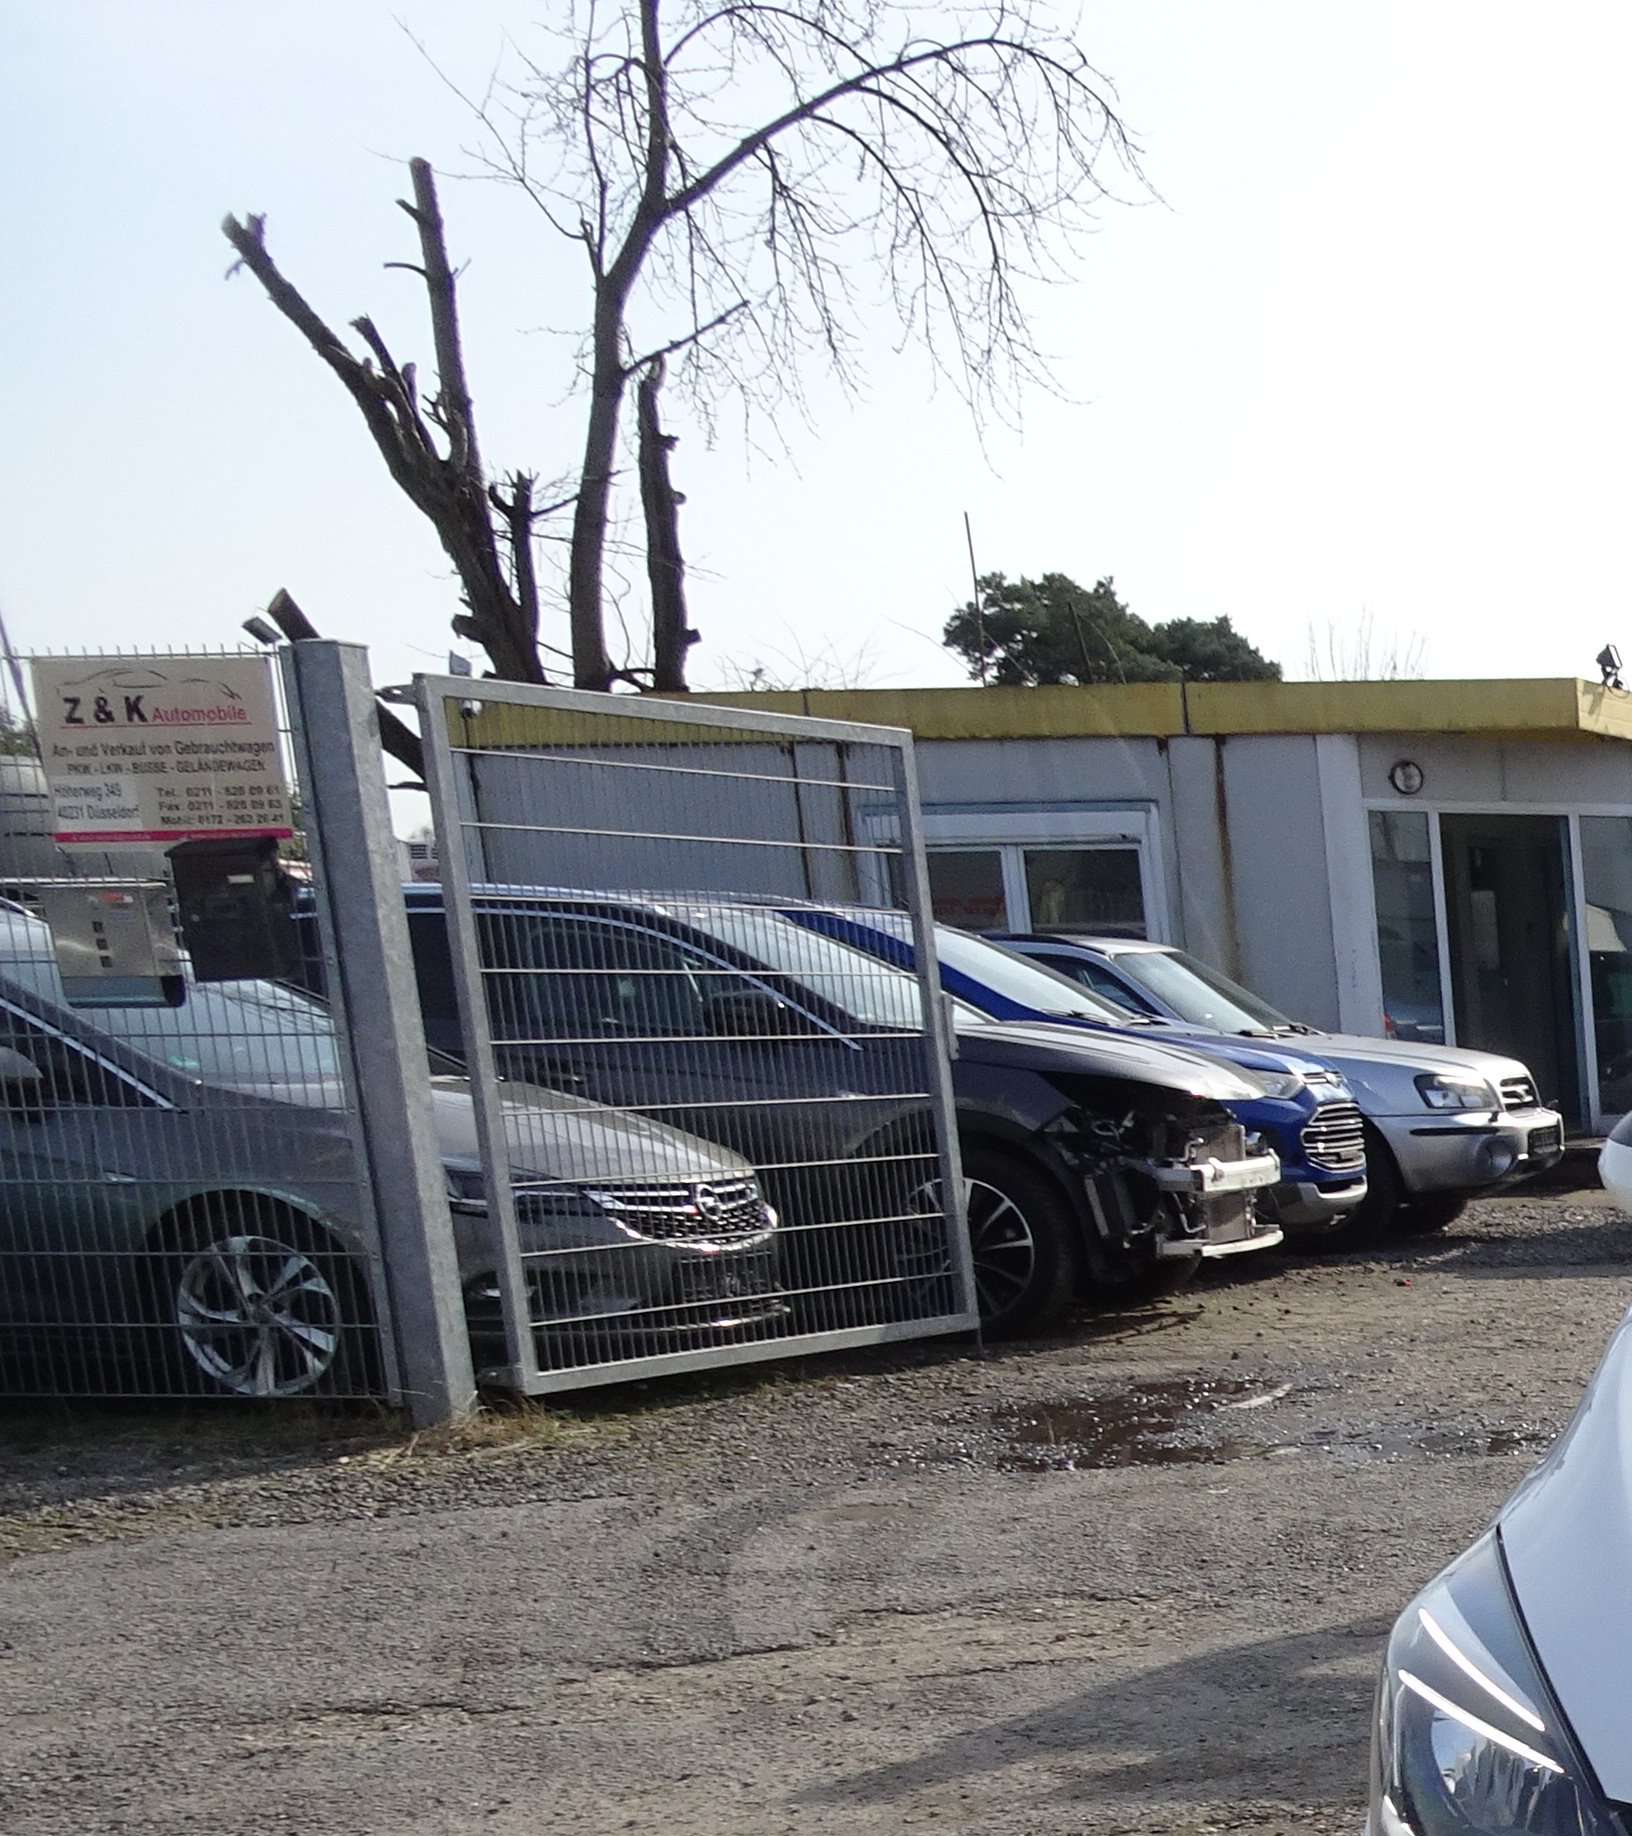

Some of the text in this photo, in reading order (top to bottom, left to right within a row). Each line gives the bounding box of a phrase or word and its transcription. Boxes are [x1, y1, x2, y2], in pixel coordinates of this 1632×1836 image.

[63, 695, 248, 724] Z & K Automobile
[100, 741, 147, 757] Verkauf
[174, 740, 275, 758] Gebrauchtwagen
